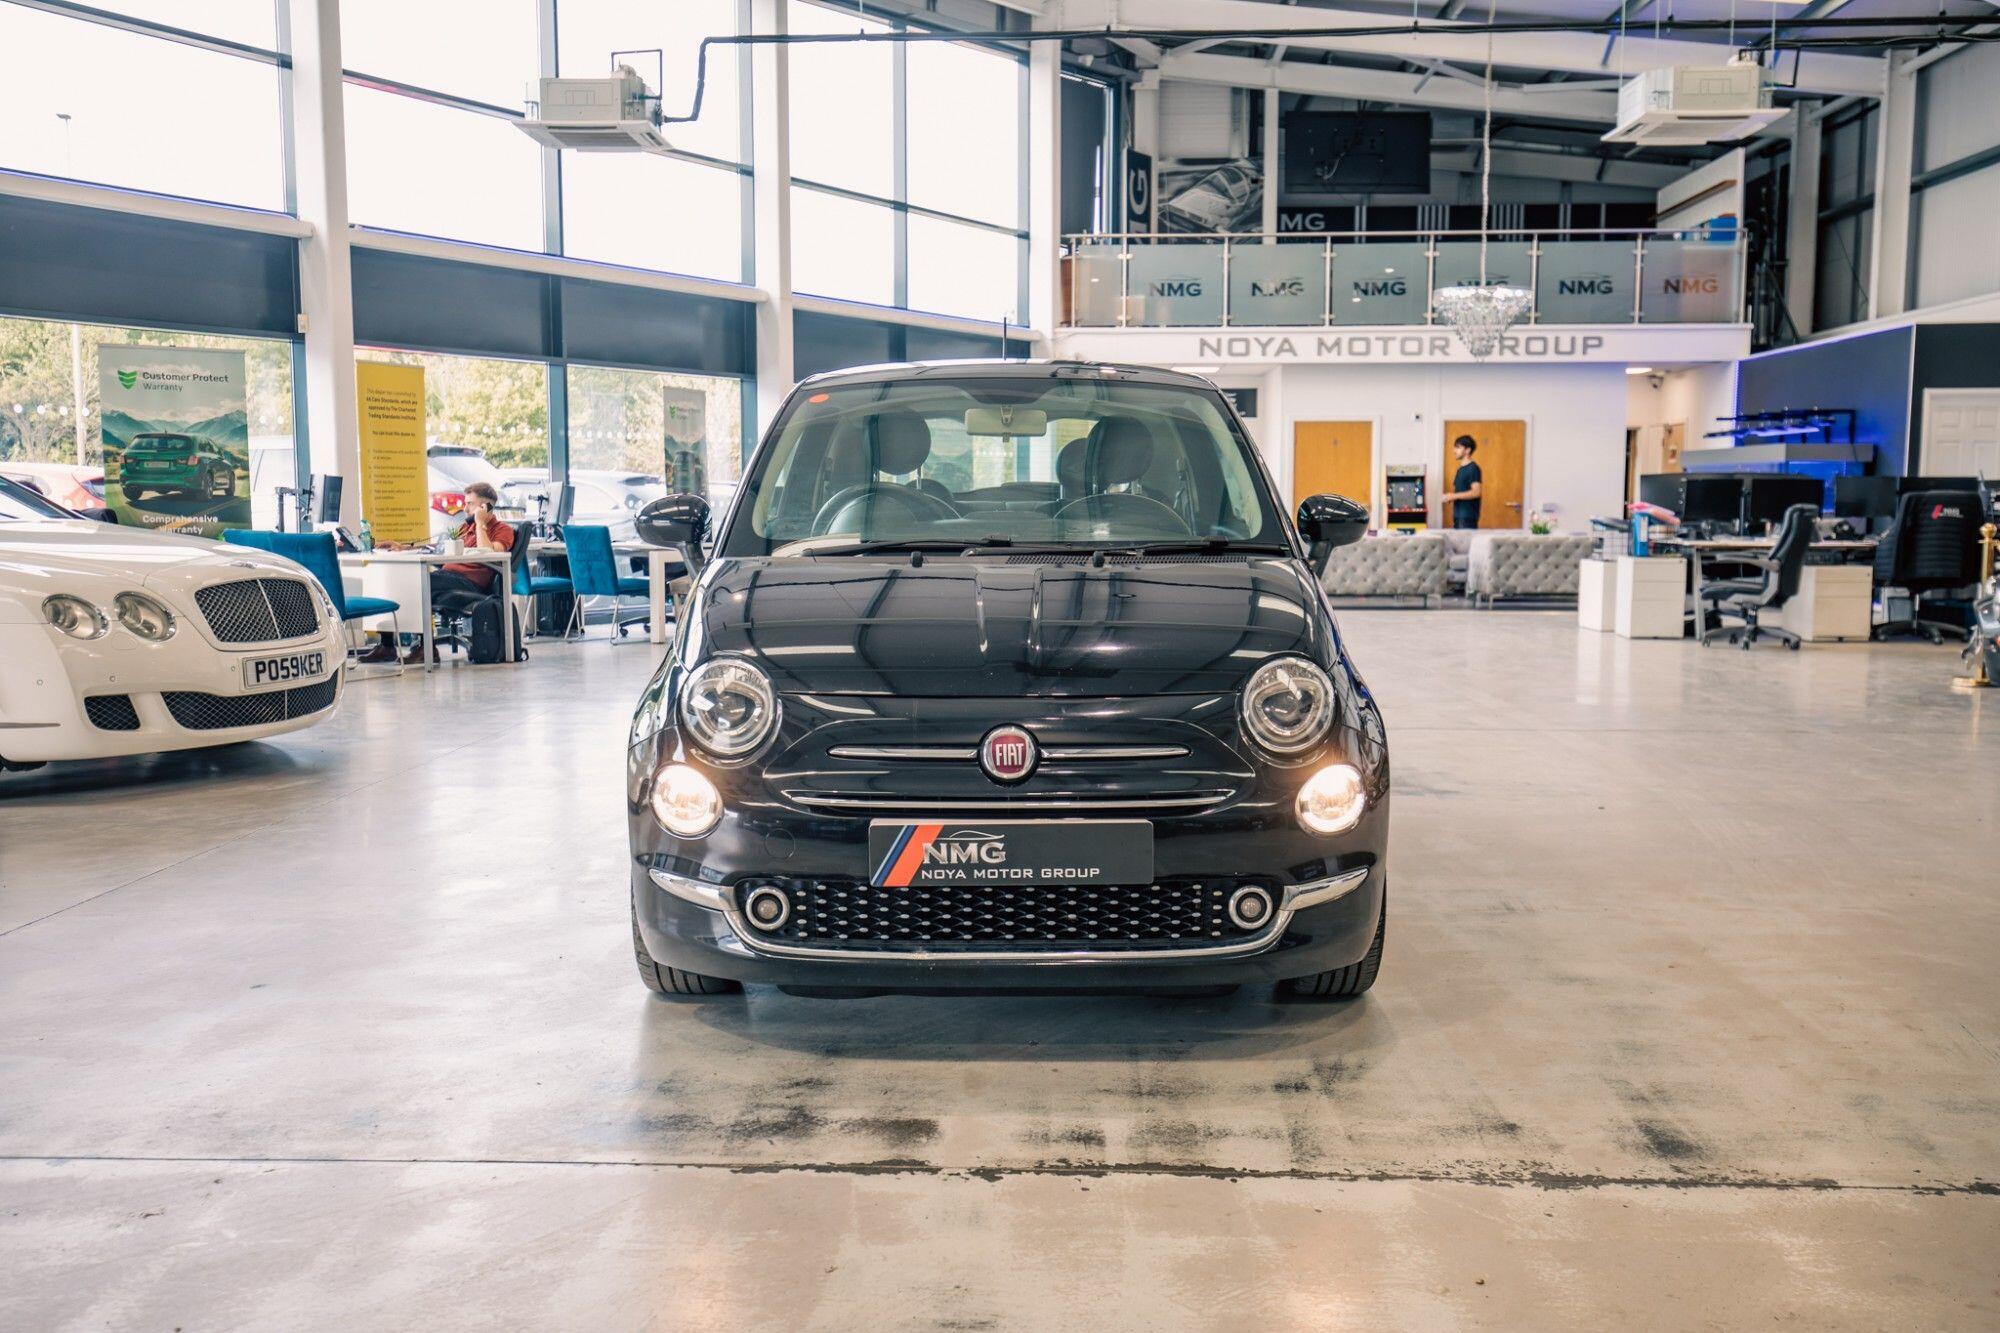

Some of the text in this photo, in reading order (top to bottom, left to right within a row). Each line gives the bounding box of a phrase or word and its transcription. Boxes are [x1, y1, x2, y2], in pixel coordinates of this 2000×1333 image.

[1149, 282, 1203, 297] NMG
[1353, 281, 1407, 296] NMG
[1558, 280, 1614, 295] NMG
[1663, 279, 1719, 294] NMG
[1199, 335, 1604, 357] NOYA MOTOR ROUP
[142, 371, 229, 383] Customer Protect
[142, 383, 184, 392] Warranty
[142, 514, 219, 525] Comprehensive
[254, 652, 324, 683] PO59KER
[994, 742, 1025, 767] FIAT
[921, 841, 1007, 865] NMG
[921, 867, 1101, 880] NOYA MOTOR GROUP
